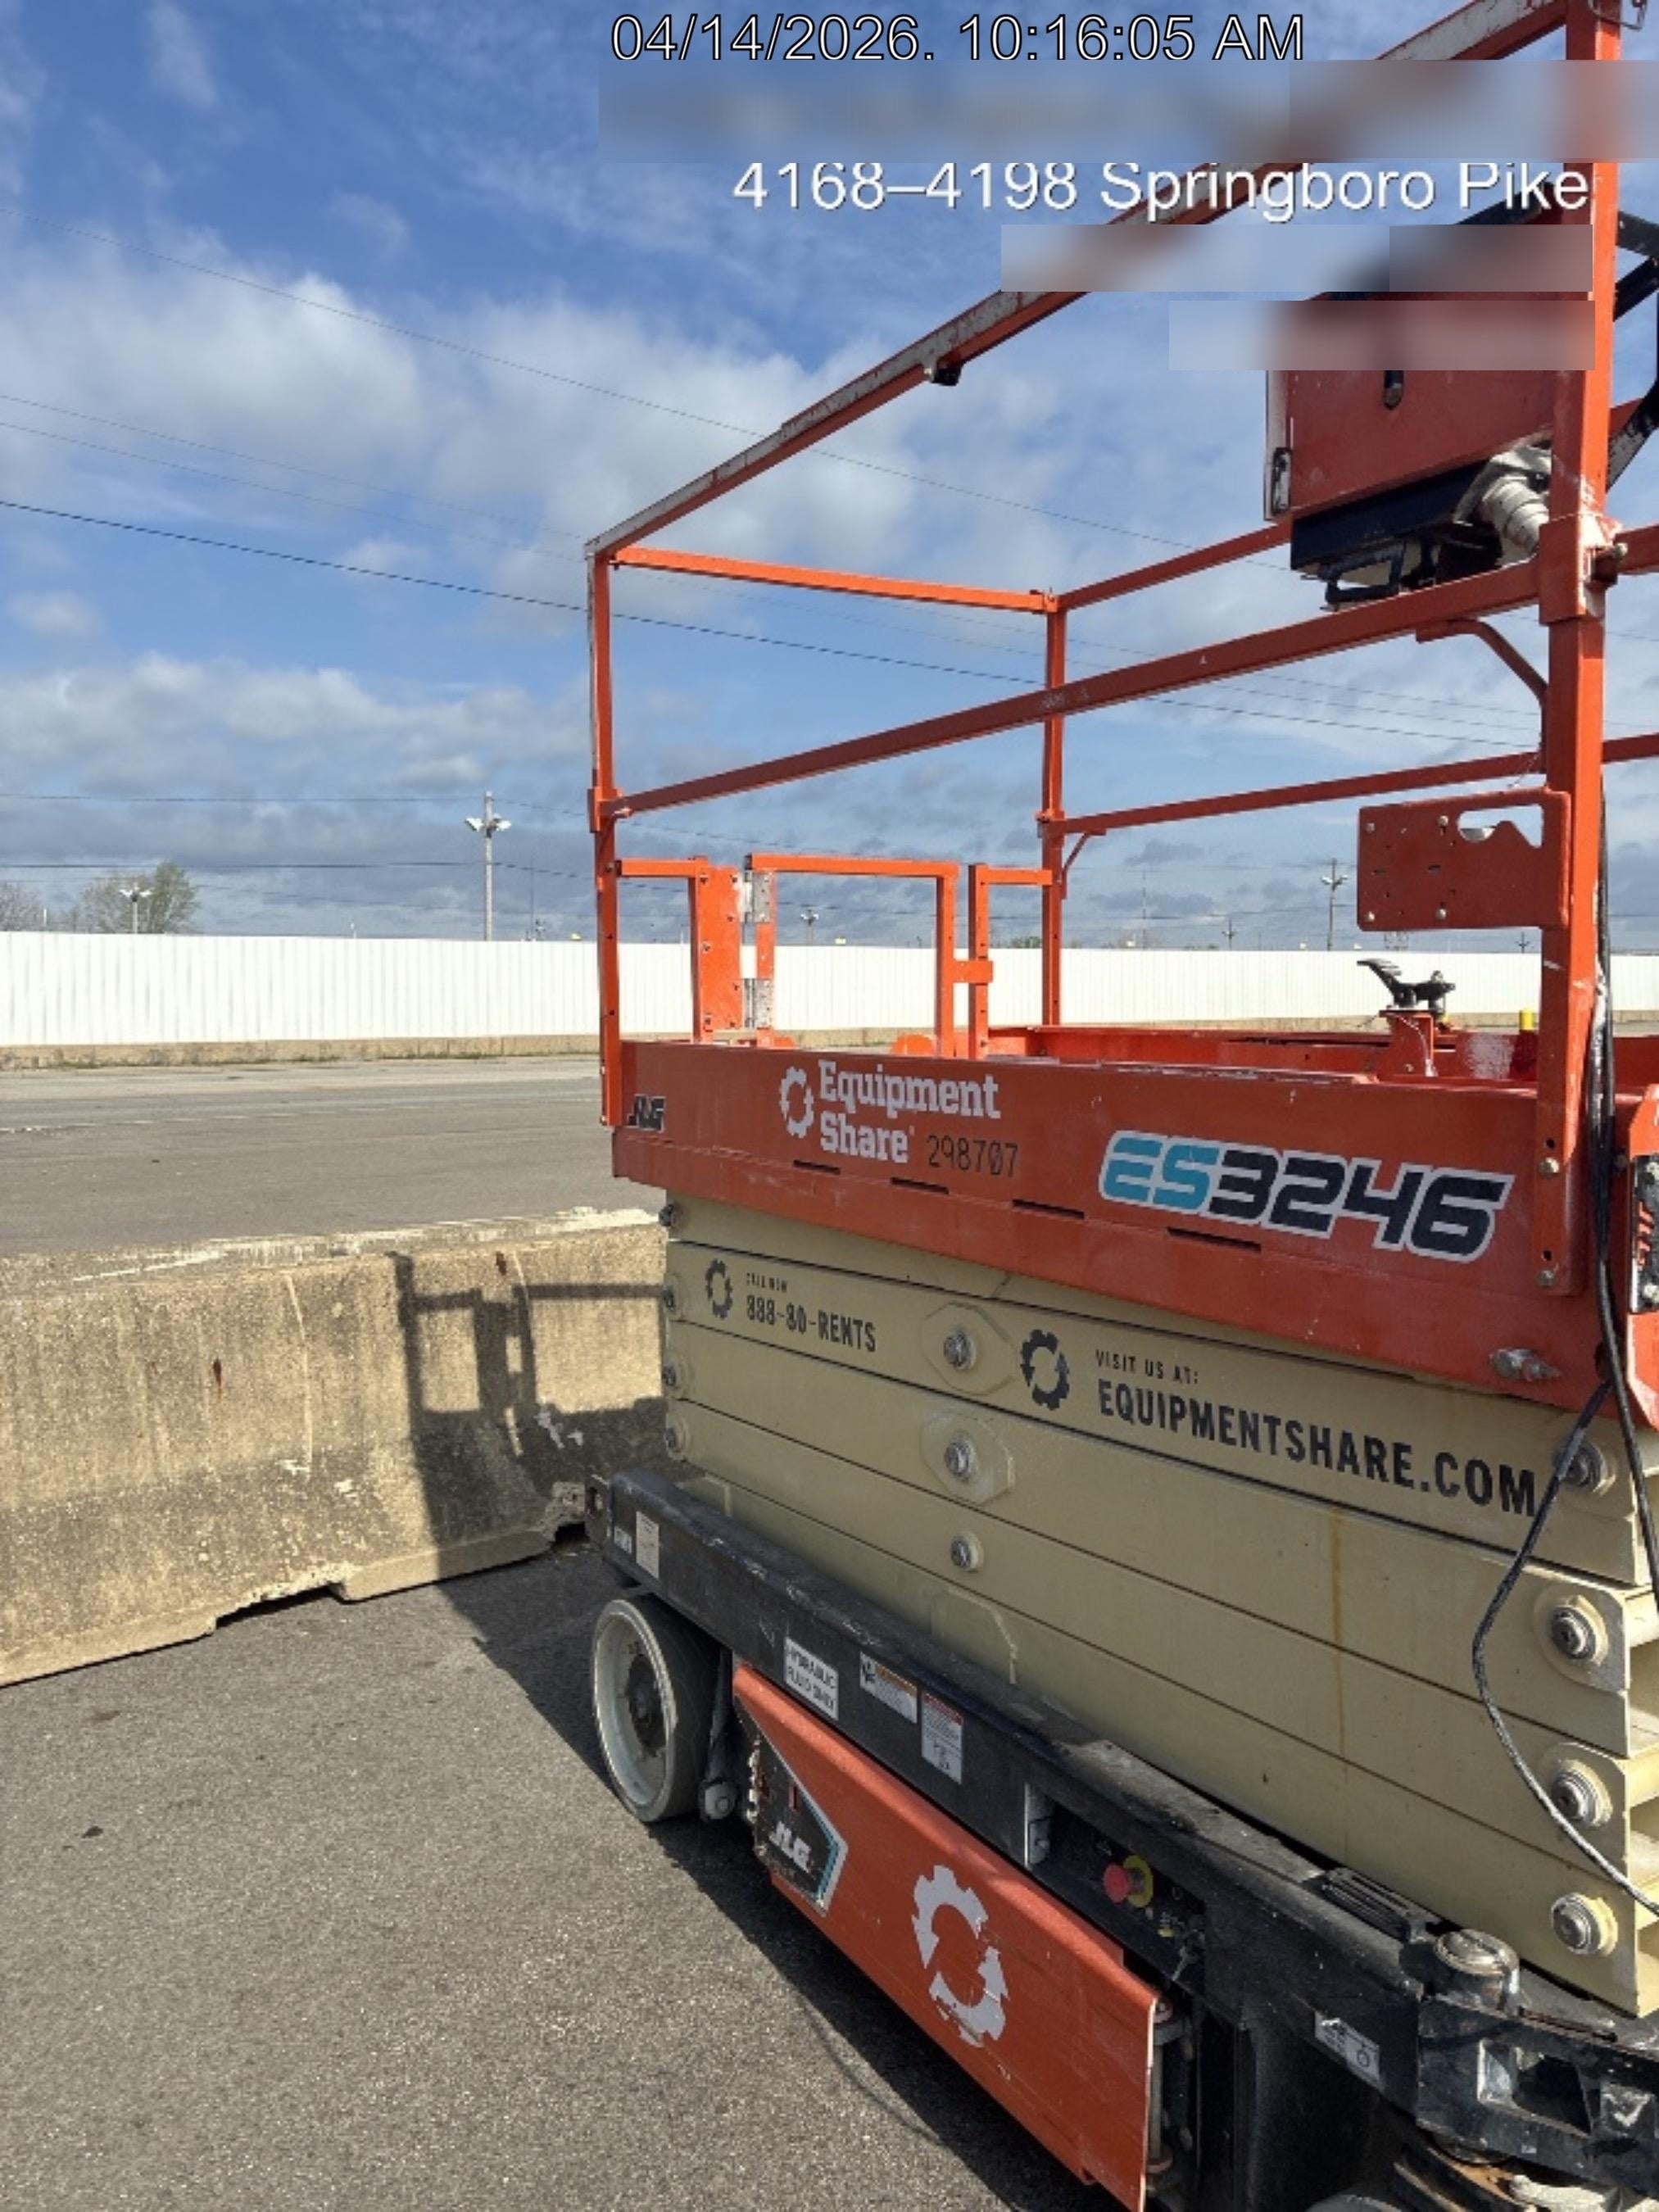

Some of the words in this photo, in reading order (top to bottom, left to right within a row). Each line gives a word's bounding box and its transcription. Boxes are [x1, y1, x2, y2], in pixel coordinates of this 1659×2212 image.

[818, 1059, 1001, 1119] Equipment
[820, 1110, 909, 1163] Share
[927, 1135, 1018, 1177] 298707
[1099, 1130, 1516, 1262] ES3246
[746, 1294, 877, 1353] 888-80-RENTS
[1095, 1349, 1136, 1374] VISIT
[1145, 1359, 1163, 1380] US
[1173, 1366, 1199, 1385] AT:
[1098, 1378, 1535, 1517] EQUIPMENTSHARE.COM
[769, 1820, 812, 1874] JLG
